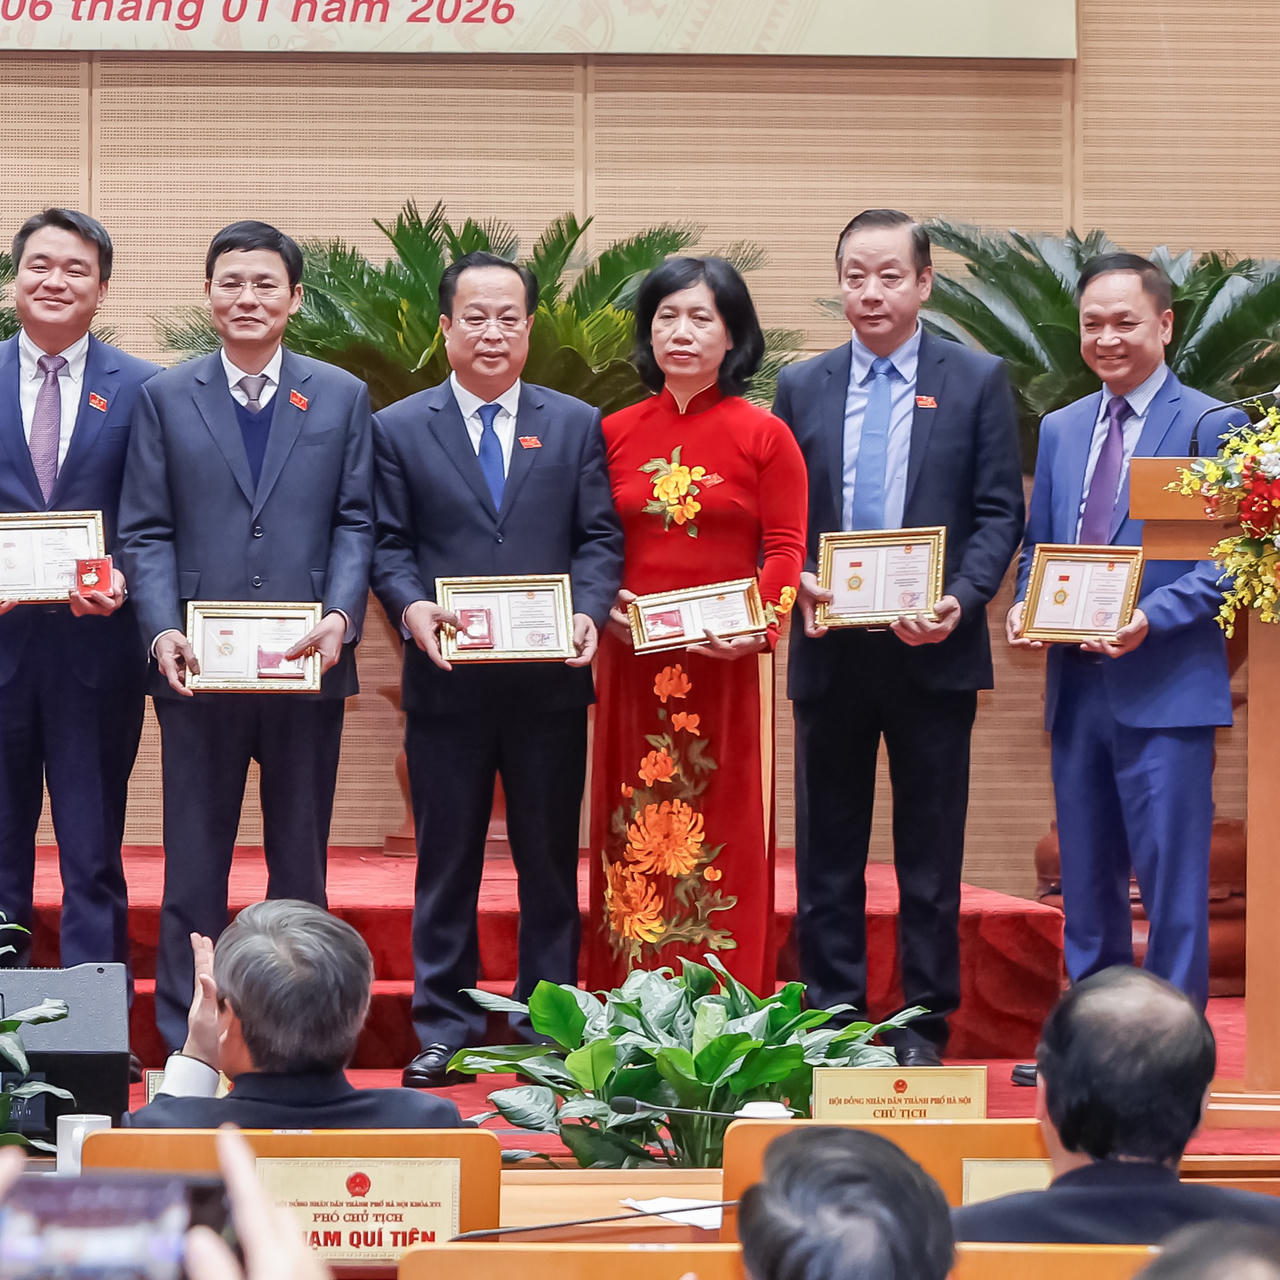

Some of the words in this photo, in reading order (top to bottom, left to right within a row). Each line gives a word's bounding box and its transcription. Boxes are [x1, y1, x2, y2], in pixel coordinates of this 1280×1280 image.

[313, 1209, 339, 1222] PHÓ
[343, 1208, 369, 1222] CHỦ
[372, 1212, 404, 1224] TỊCH
[349, 1227, 383, 1249] QUÍ
